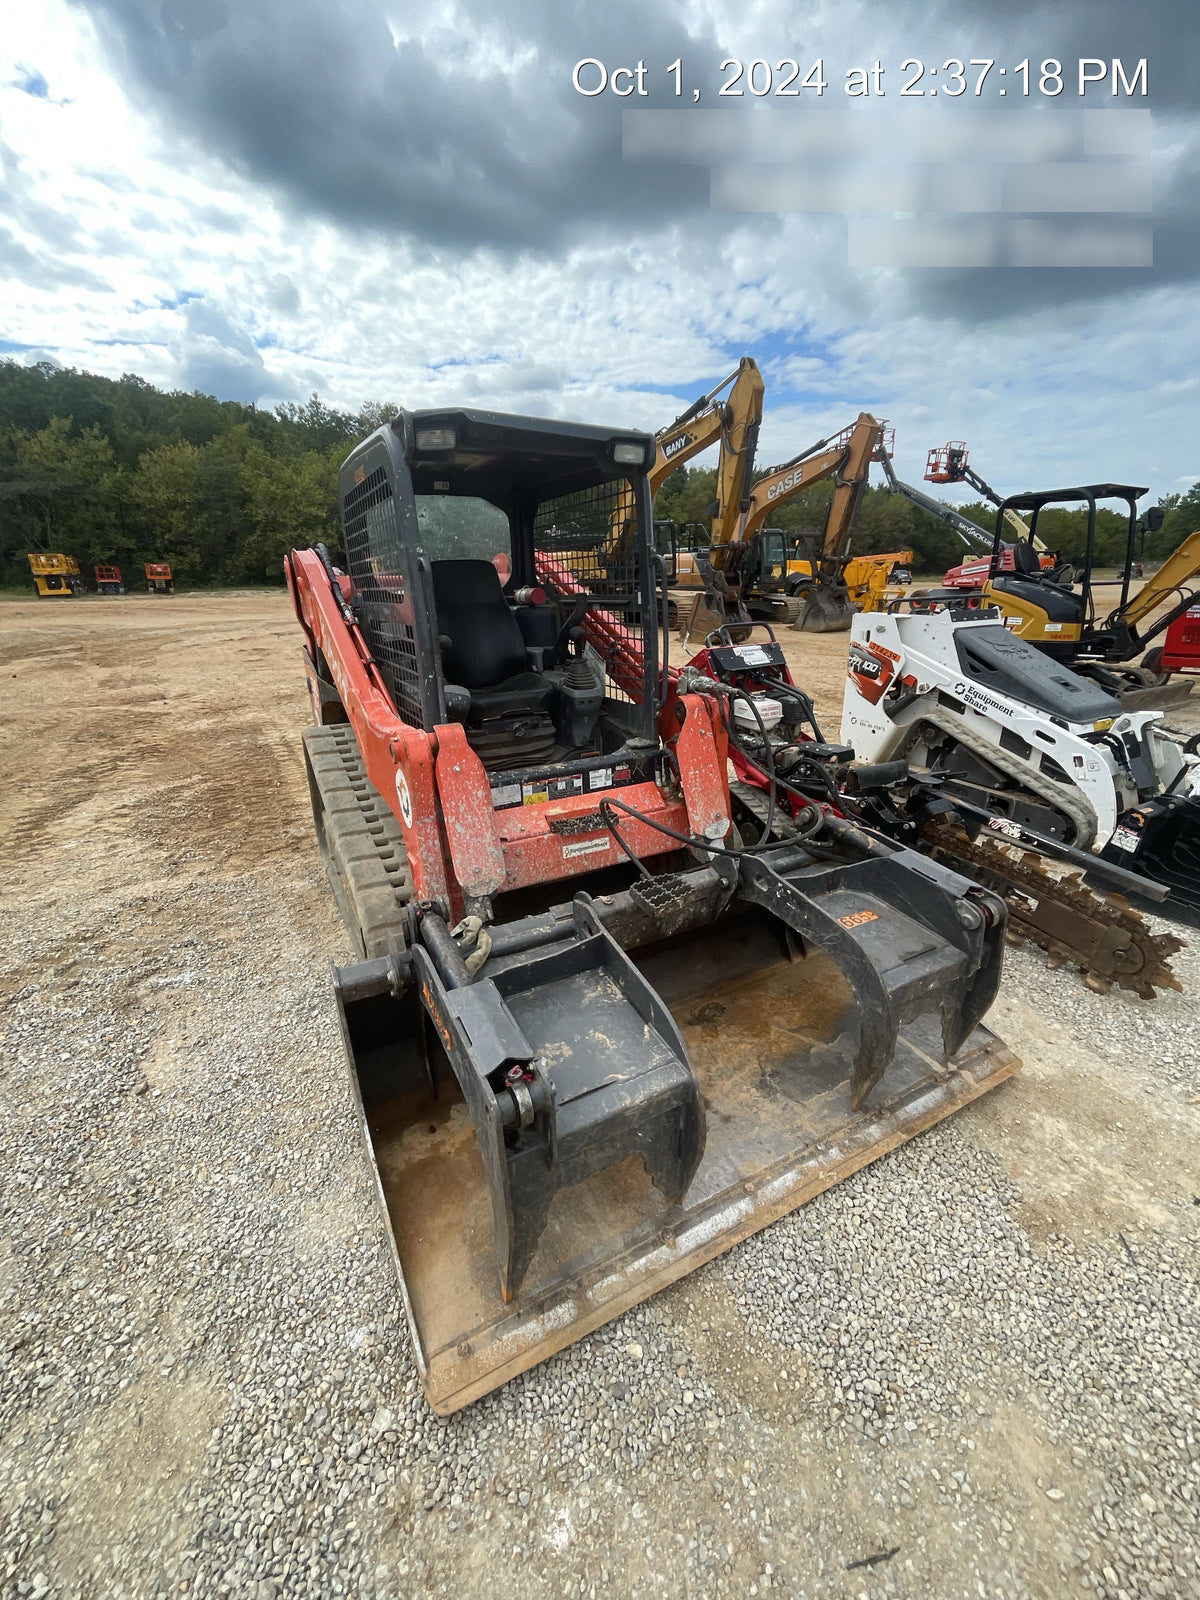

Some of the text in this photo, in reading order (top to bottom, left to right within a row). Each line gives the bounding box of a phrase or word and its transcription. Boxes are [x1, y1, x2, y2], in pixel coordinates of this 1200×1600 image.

[665, 435, 687, 454] SANY
[767, 467, 803, 500] CASE
[963, 693, 989, 713] Share
[967, 685, 1015, 717] Equipment
